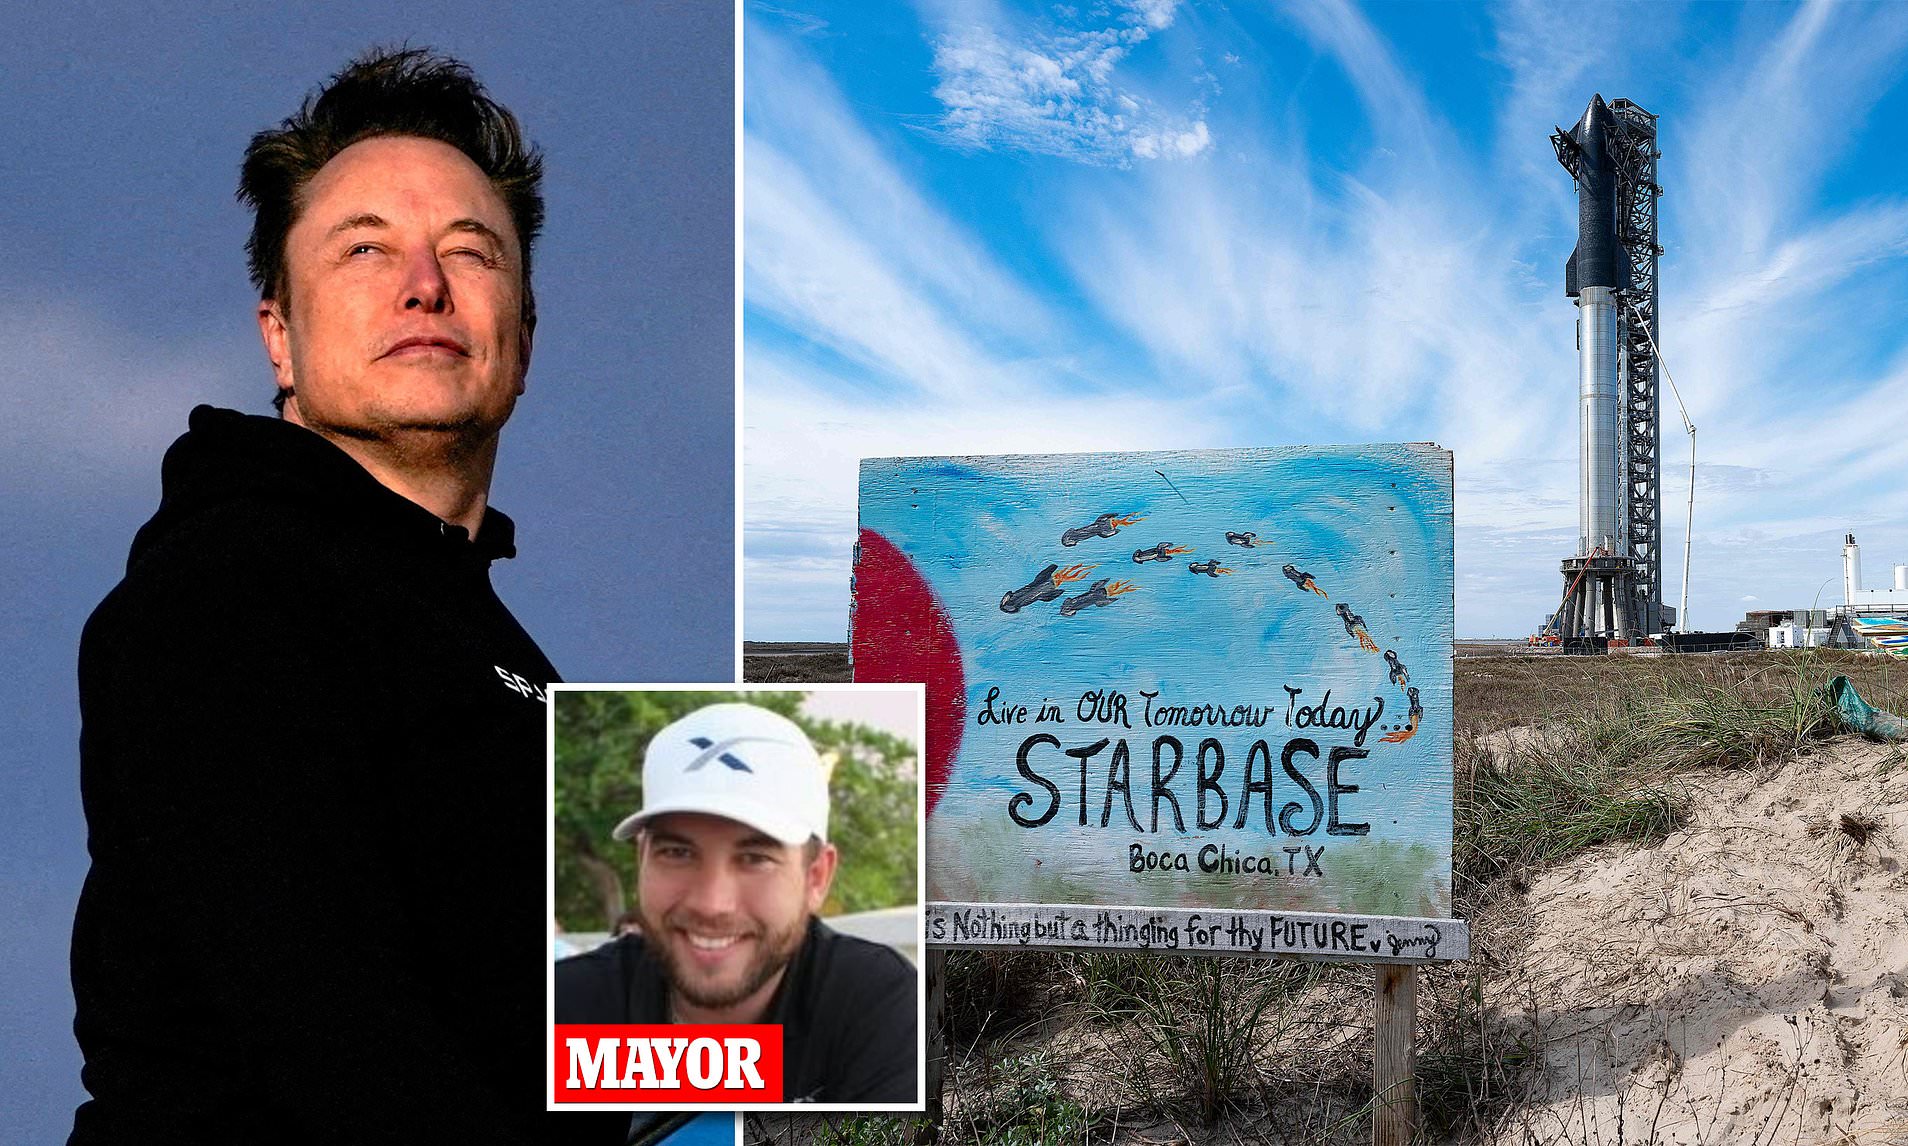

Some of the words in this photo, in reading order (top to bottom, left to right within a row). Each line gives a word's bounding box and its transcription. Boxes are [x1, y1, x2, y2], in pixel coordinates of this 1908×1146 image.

[977, 686, 1028, 725] Live
[1035, 697, 1065, 724] in
[1076, 688, 1132, 729] OUR
[1139, 690, 1275, 727] Tomorrow
[1008, 733, 1371, 837] STARBASE
[1129, 843, 1190, 874] Boca
[1282, 845, 1325, 877] TX
[953, 907, 1031, 945] Nothing
[1034, 910, 1073, 940] but
[1071, 918, 1090, 941] a
[1184, 914, 1222, 947] for
[1226, 915, 1264, 951] thy
[1270, 915, 1369, 951] FUTURE
